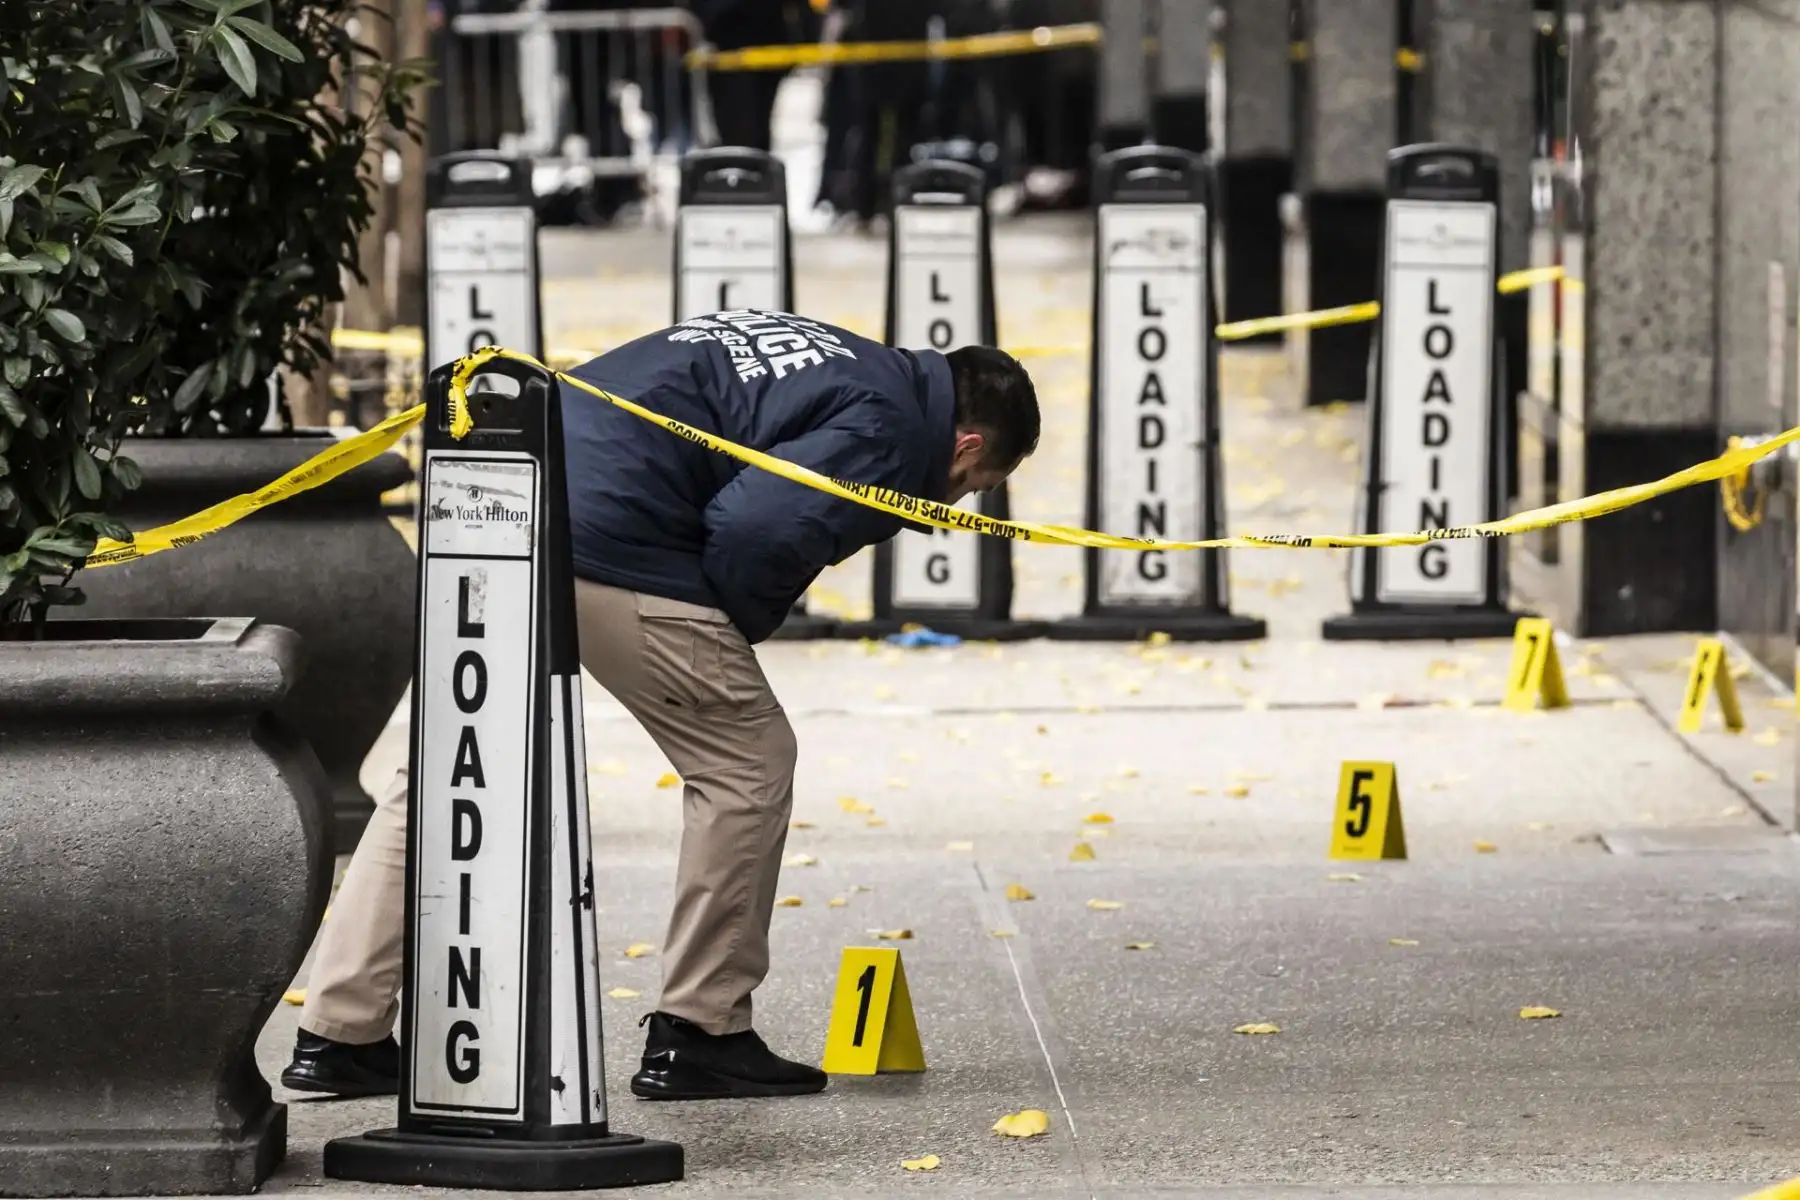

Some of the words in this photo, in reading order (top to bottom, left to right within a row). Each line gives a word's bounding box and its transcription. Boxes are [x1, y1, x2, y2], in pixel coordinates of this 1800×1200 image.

[713, 329, 768, 384] SCENE
[715, 309, 825, 380] OLICE
[1138, 281, 1167, 581] LOADING
[1417, 278, 1455, 580] LOADING
[456, 505, 482, 520] York
[485, 505, 528, 521] Hilton
[445, 576, 488, 1085] LOADING
[1345, 770, 1374, 838] 5
[852, 965, 877, 1047] 1
